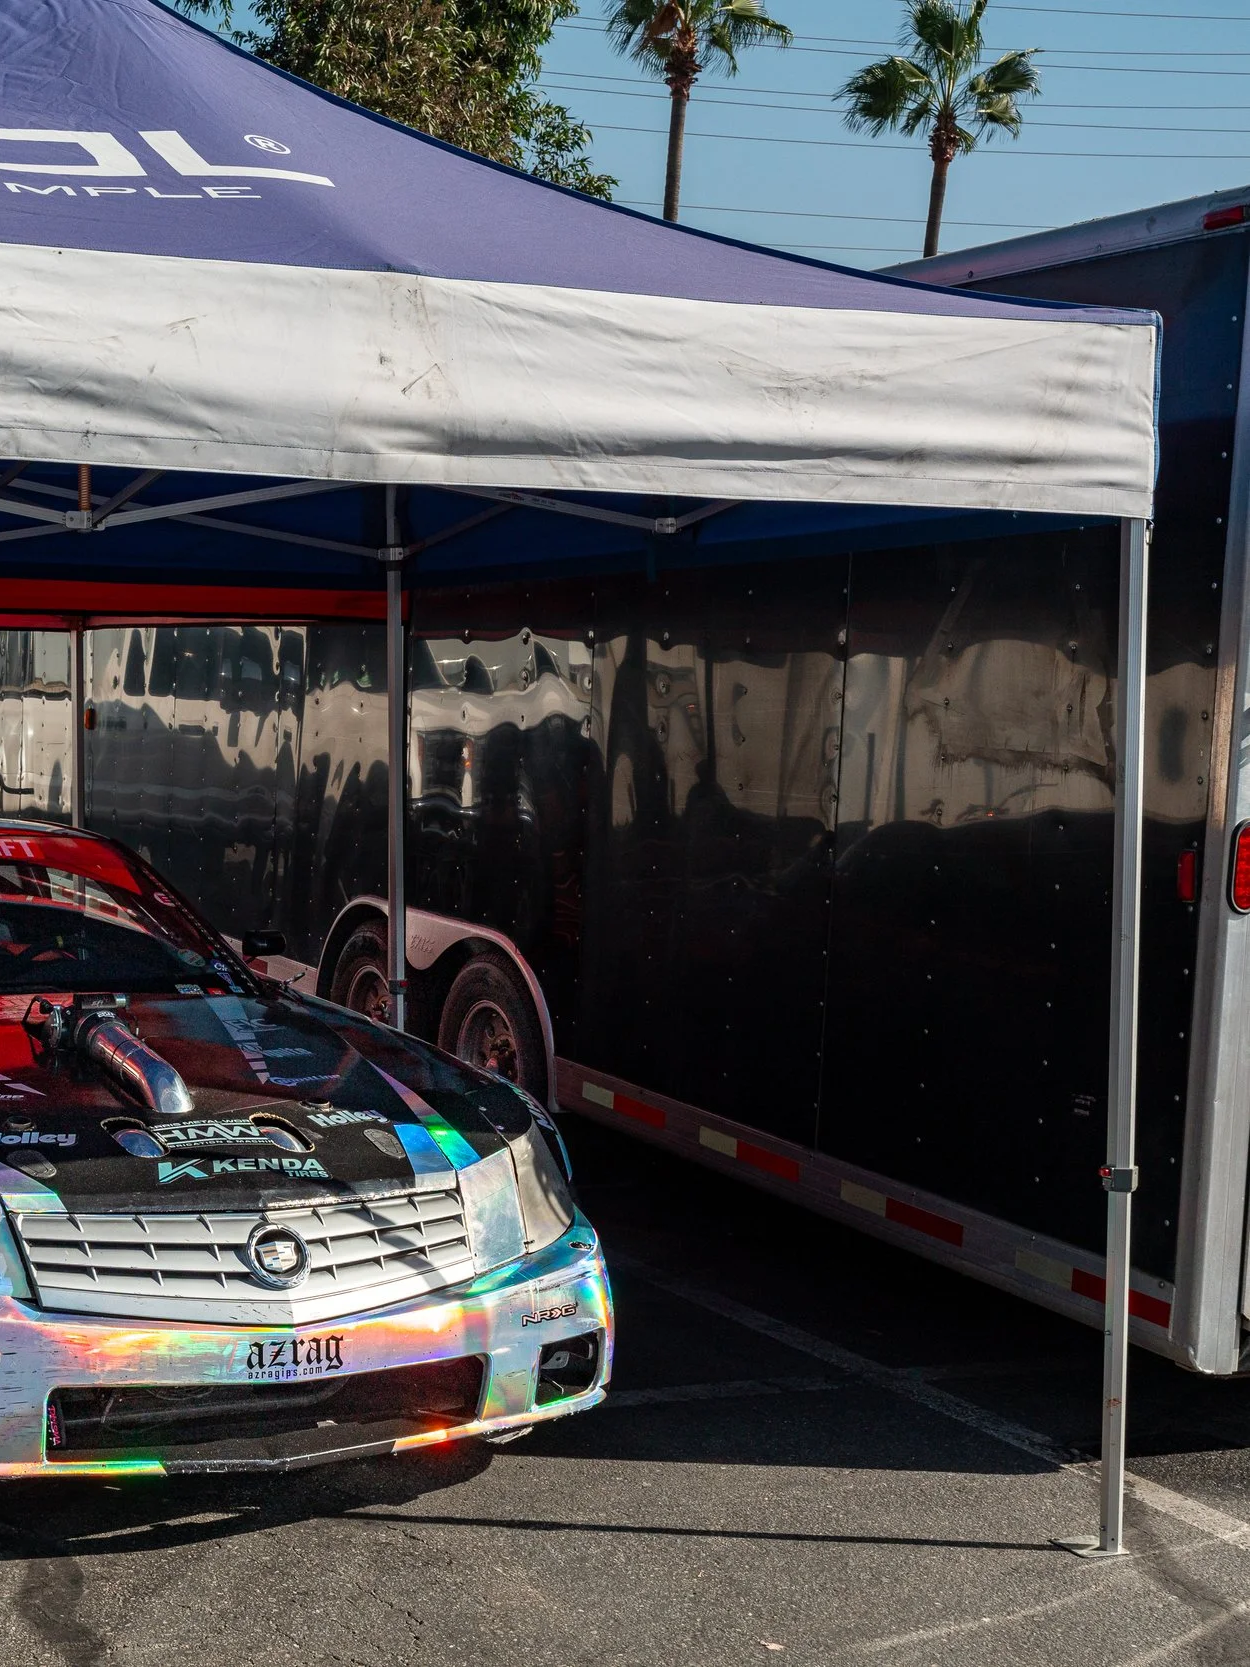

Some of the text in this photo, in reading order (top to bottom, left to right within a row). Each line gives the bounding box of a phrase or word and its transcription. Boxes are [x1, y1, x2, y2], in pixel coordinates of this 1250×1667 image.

[307, 1109, 388, 1127] Holley
[212, 1158, 325, 1174] KENDA
[287, 1169, 330, 1179] TIRES
[246, 1334, 344, 1372] azrag
[247, 1365, 323, 1380] azragips.com
